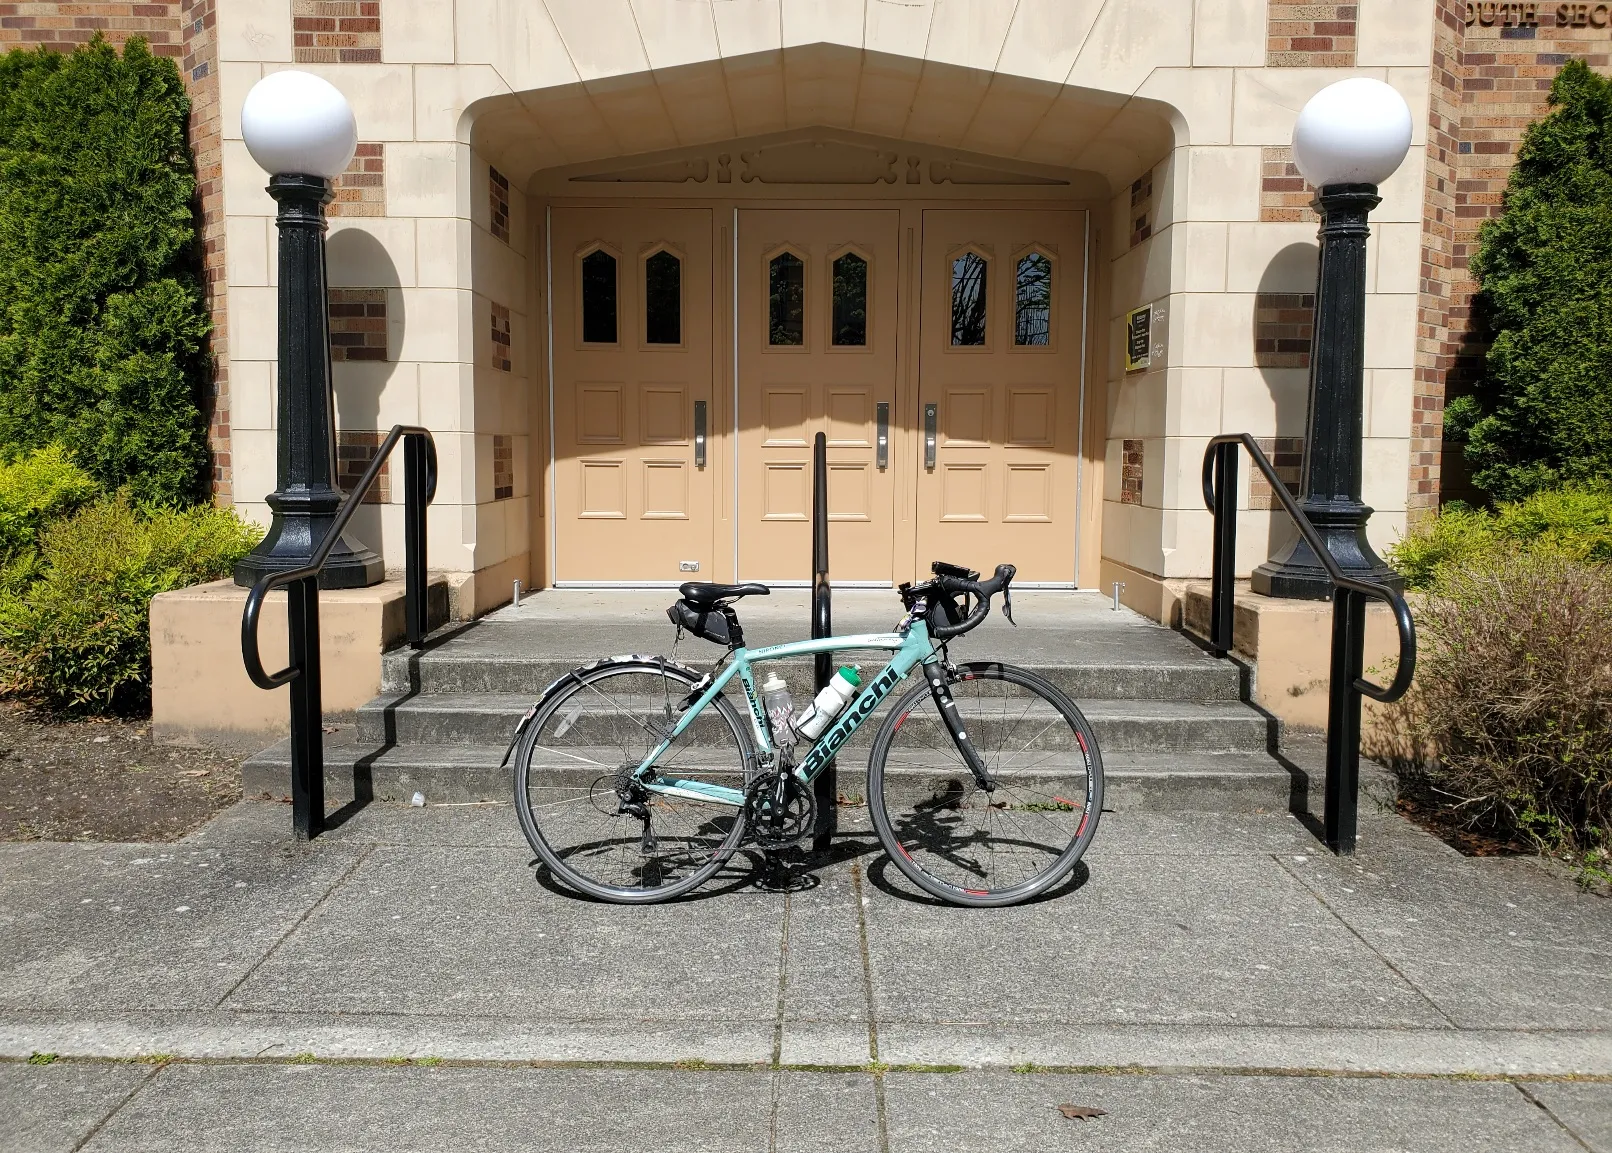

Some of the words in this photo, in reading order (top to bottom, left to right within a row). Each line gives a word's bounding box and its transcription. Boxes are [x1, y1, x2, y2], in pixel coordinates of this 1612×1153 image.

[1556, 4, 1612, 28] SEC
[742, 678, 765, 728] Bianchi
[801, 665, 899, 779] Bianchi
